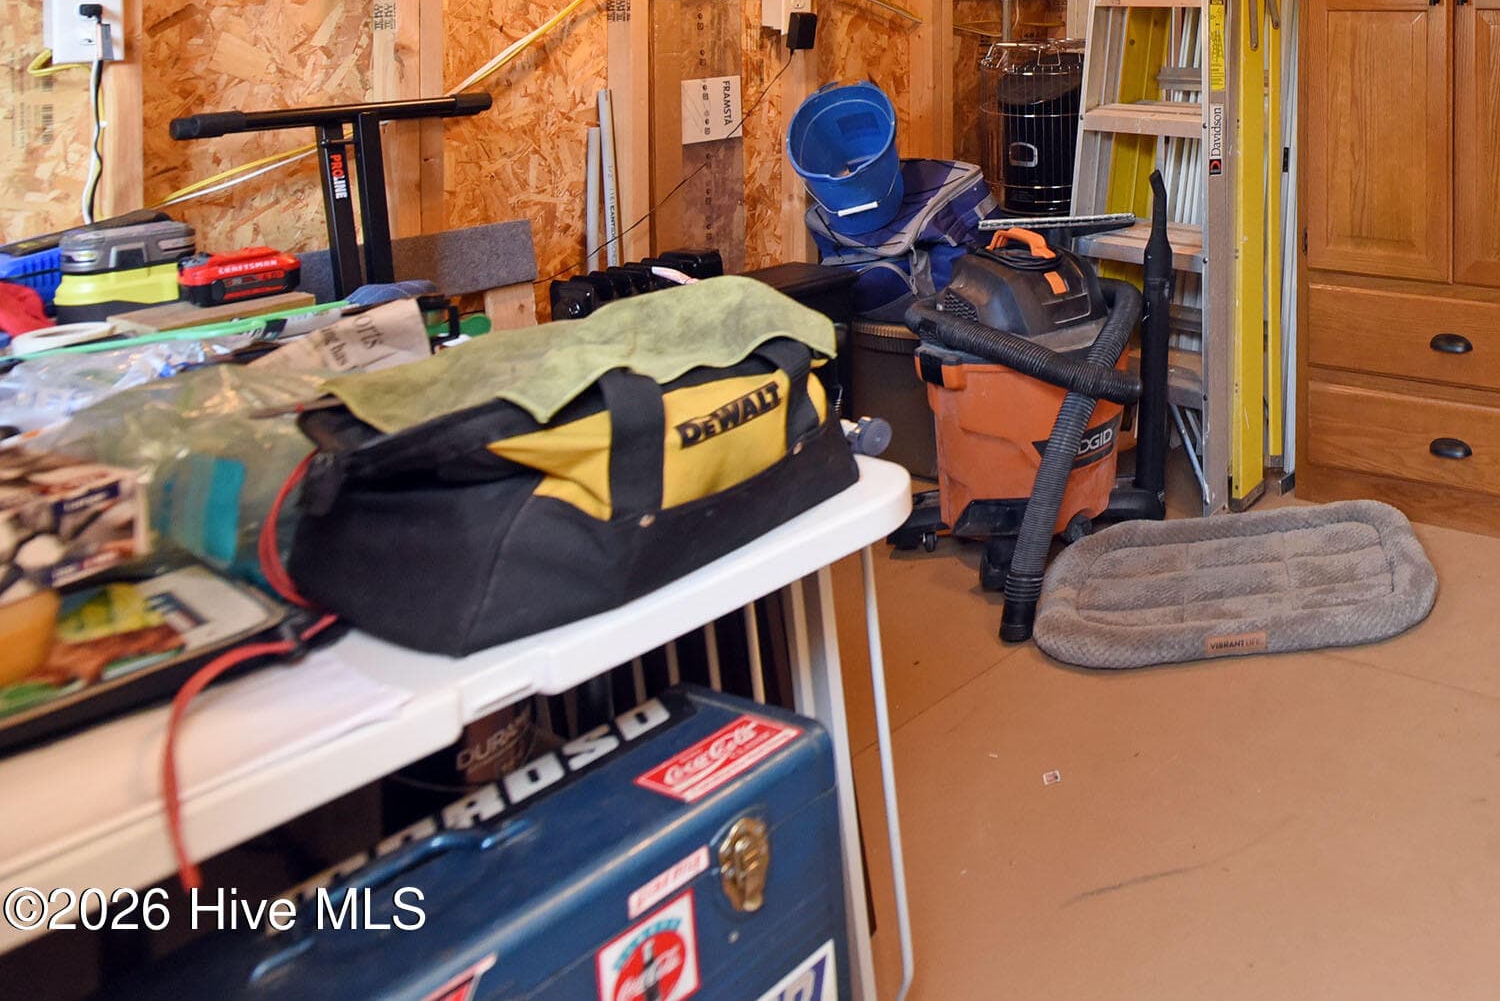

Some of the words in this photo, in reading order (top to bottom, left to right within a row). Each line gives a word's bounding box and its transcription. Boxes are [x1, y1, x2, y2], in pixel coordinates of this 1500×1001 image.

[1210, 107, 1222, 157] Davidson
[330, 153, 347, 199] PROLINE
[219, 259, 277, 275] CRAFTSMAN
[1078, 428, 1113, 455] DGID
[1210, 640, 1245, 650] VIBRANT
